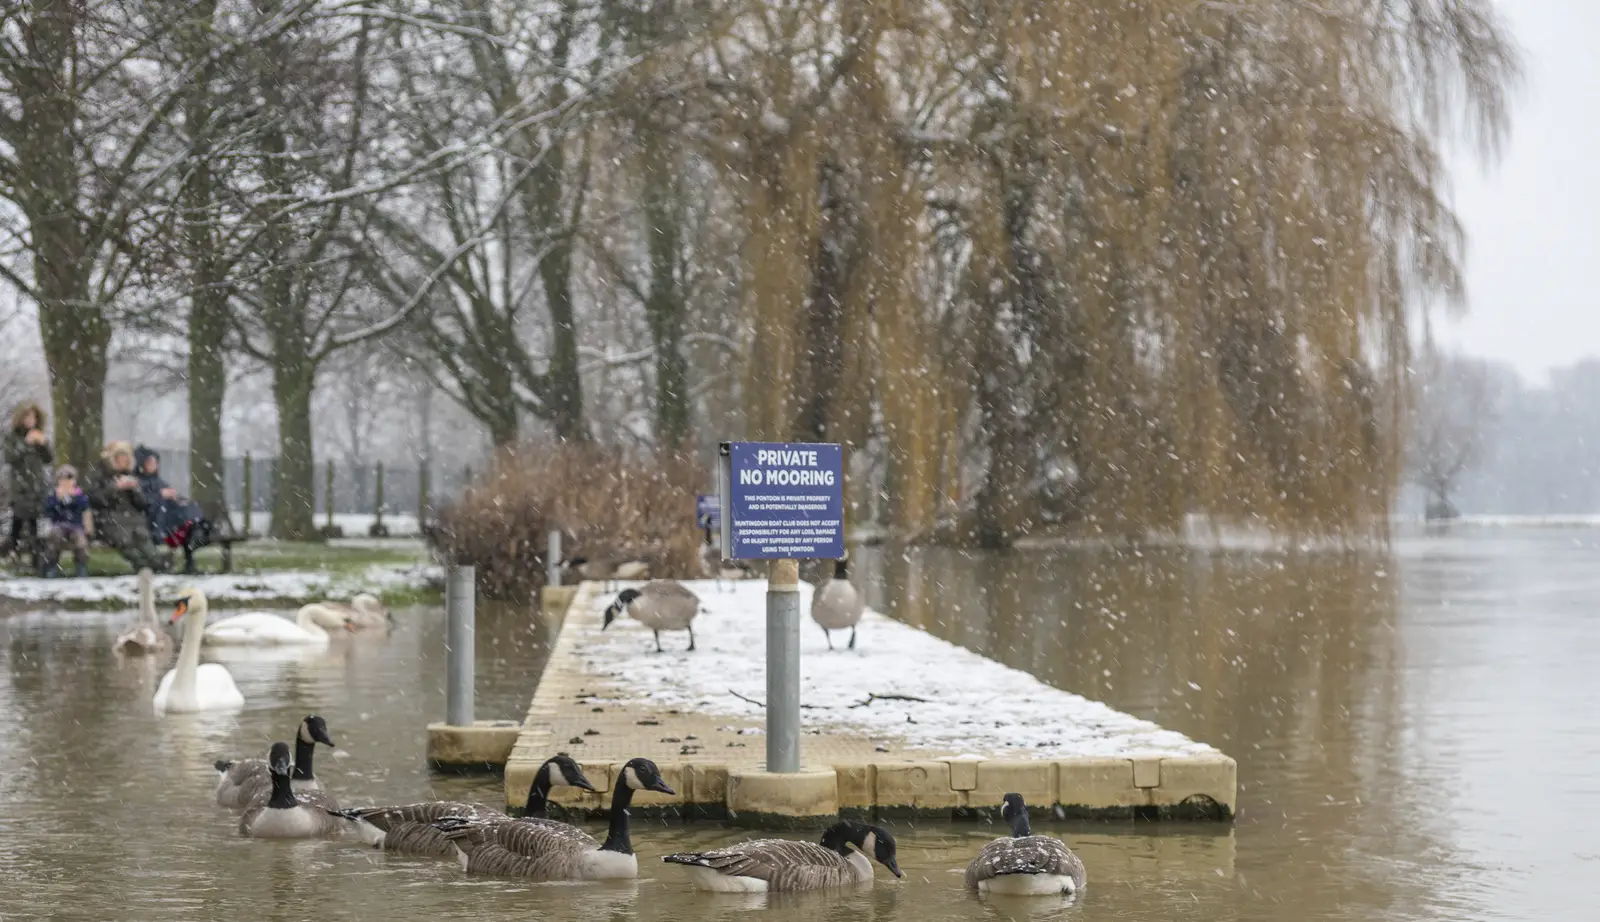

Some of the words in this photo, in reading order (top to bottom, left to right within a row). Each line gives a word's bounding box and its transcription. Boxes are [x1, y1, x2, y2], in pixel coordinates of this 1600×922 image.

[758, 450, 818, 466] PRIVATE
[740, 469, 763, 485] NO
[766, 470, 835, 486] MOORING
